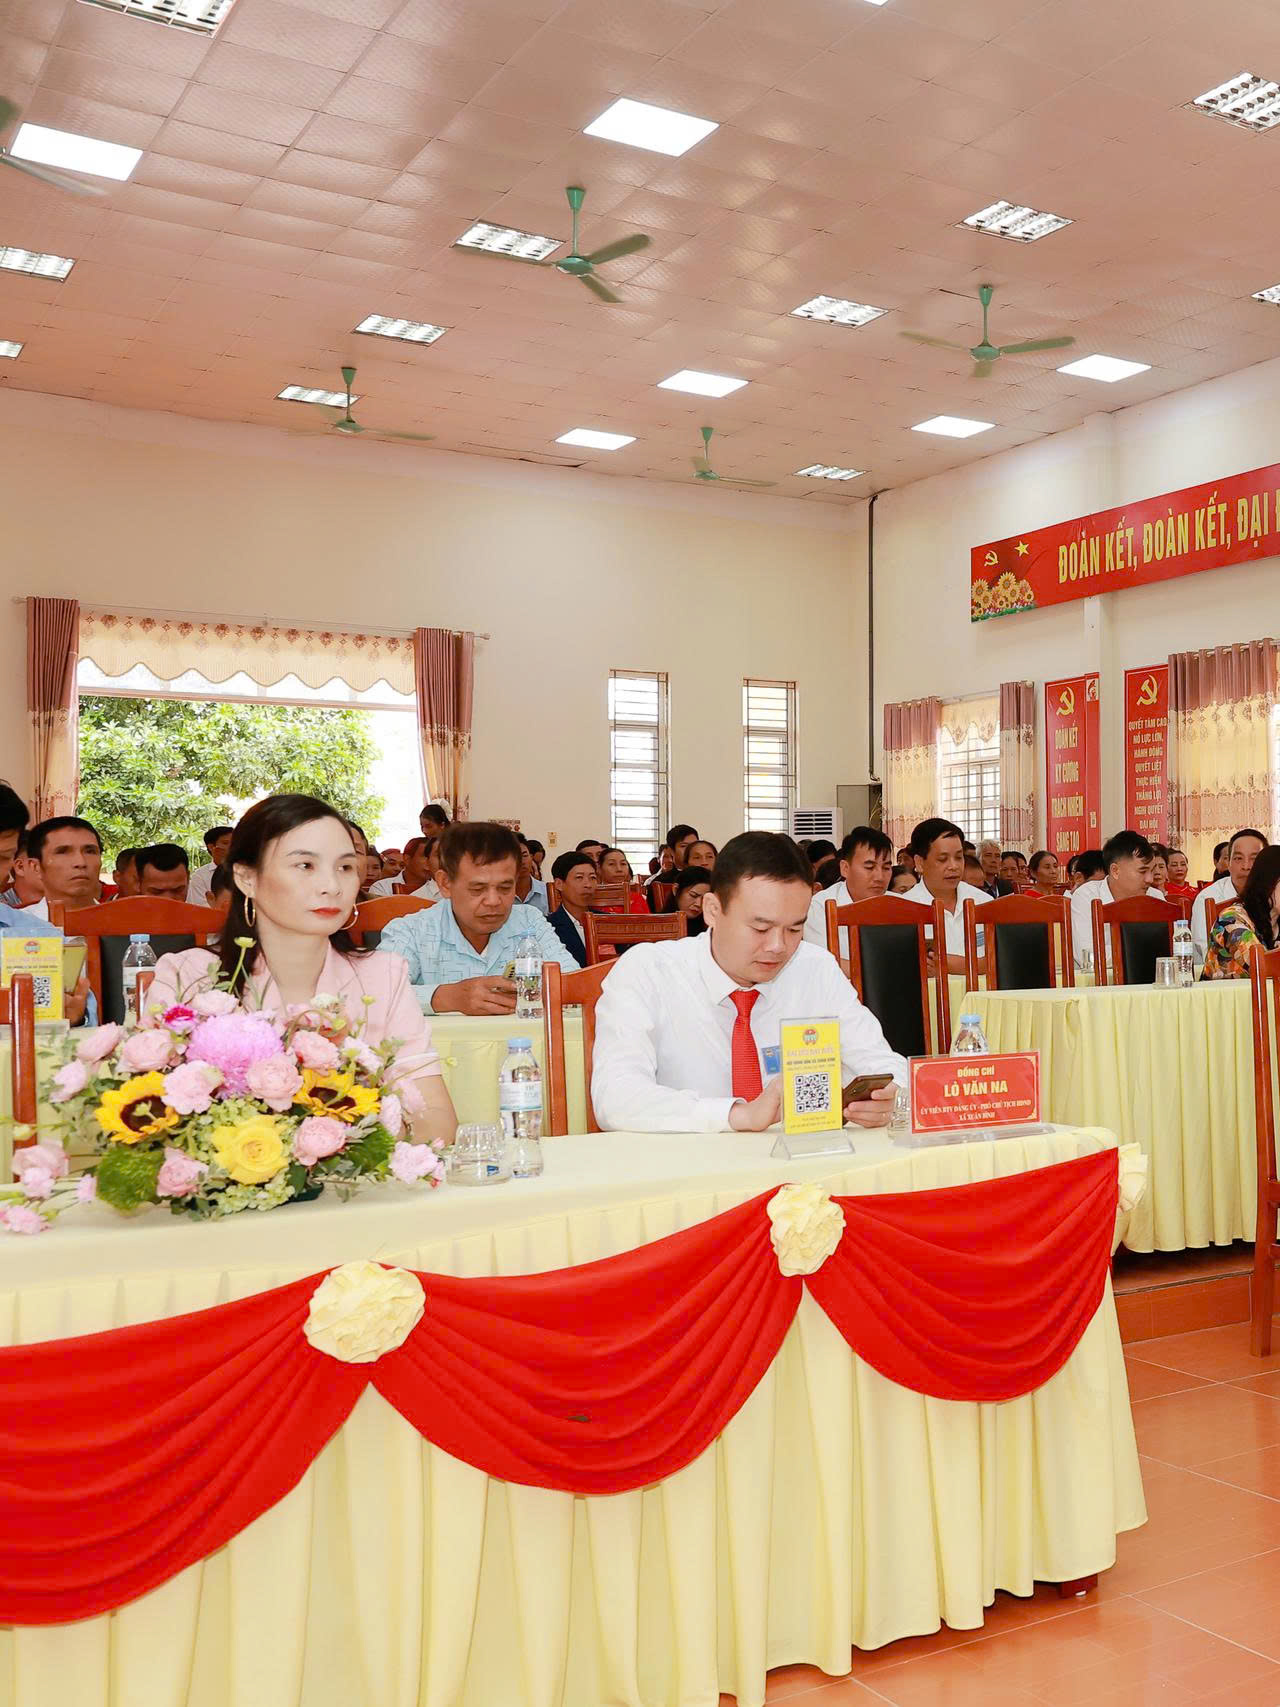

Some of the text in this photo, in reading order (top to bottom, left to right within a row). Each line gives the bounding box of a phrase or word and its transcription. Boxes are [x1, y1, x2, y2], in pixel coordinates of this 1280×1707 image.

[1059, 530, 1099, 583] ĐOÀN
[1105, 516, 1138, 571] KẾT,
[1143, 508, 1188, 564] ĐOÀN
[1195, 491, 1231, 550] KẾT,
[1237, 492, 1268, 547] ĐẠI
[957, 1065, 995, 1078] ĐỒNG CHÍ
[963, 1081, 987, 1096] VĂN
[991, 1081, 1008, 1093] NA
